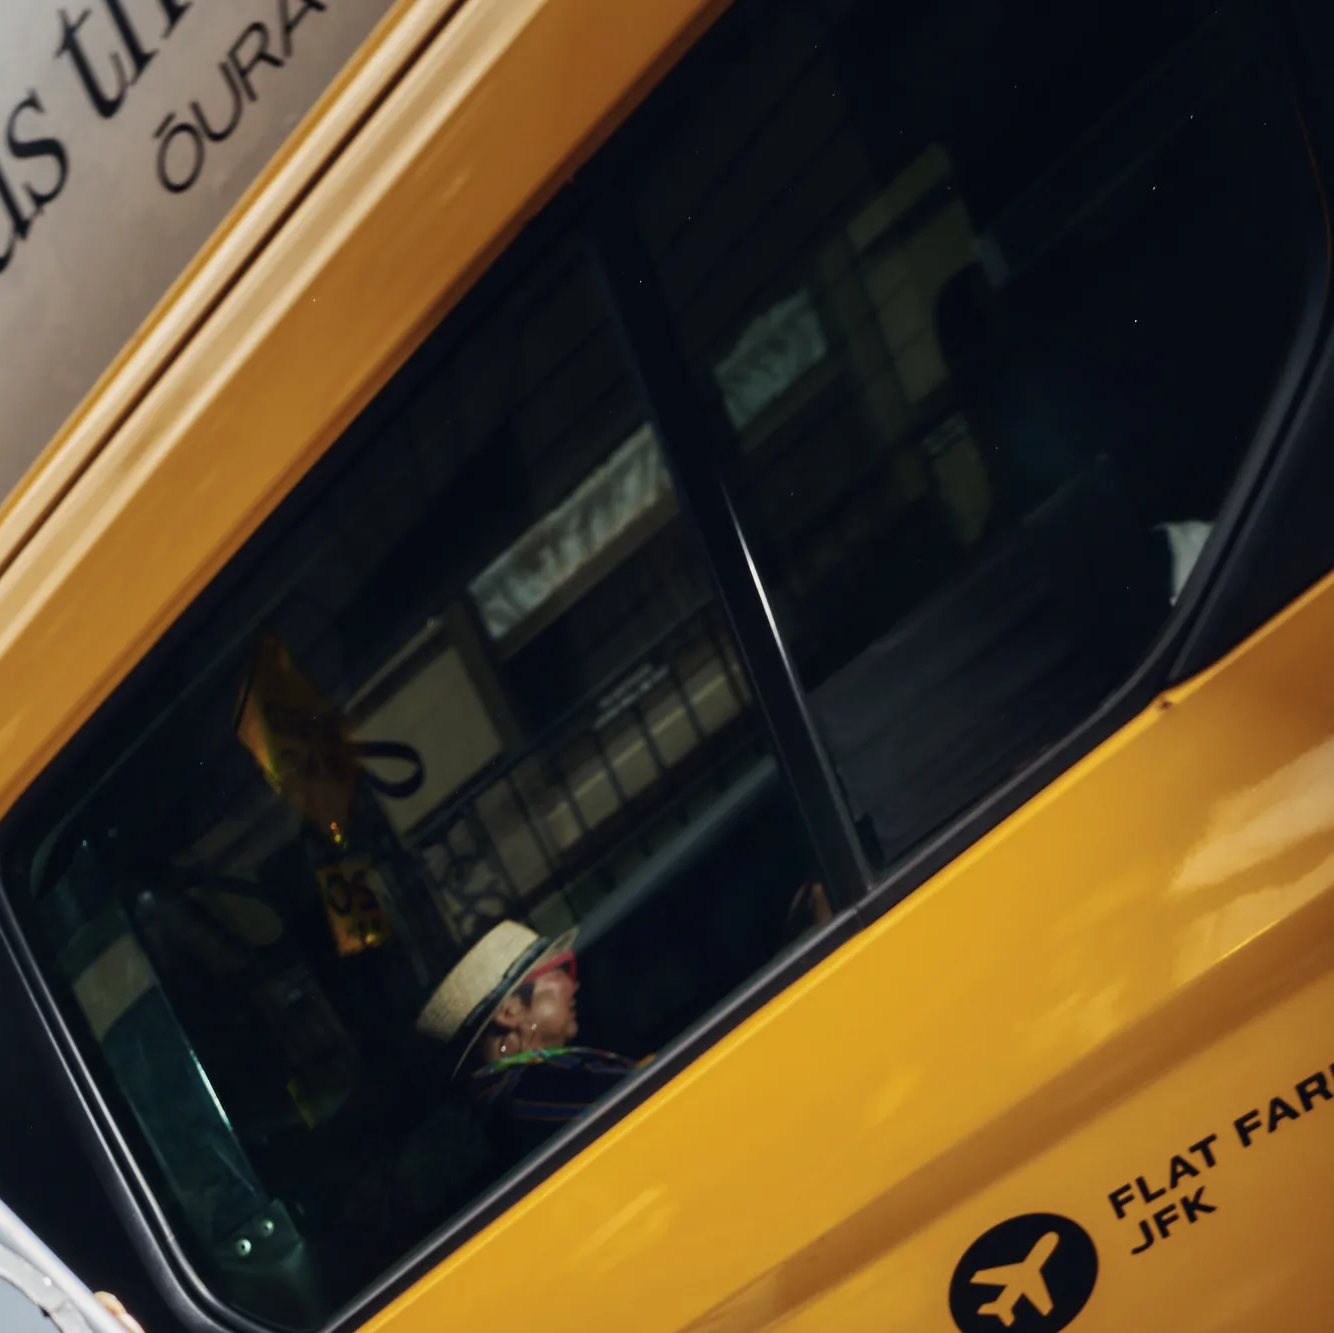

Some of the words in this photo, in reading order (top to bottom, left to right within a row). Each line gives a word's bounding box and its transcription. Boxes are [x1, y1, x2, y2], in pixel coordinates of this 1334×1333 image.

[1107, 1133, 1218, 1221] FLAT
[1233, 1061, 1334, 1148] FAR
[1130, 1185, 1218, 1256] JFK
